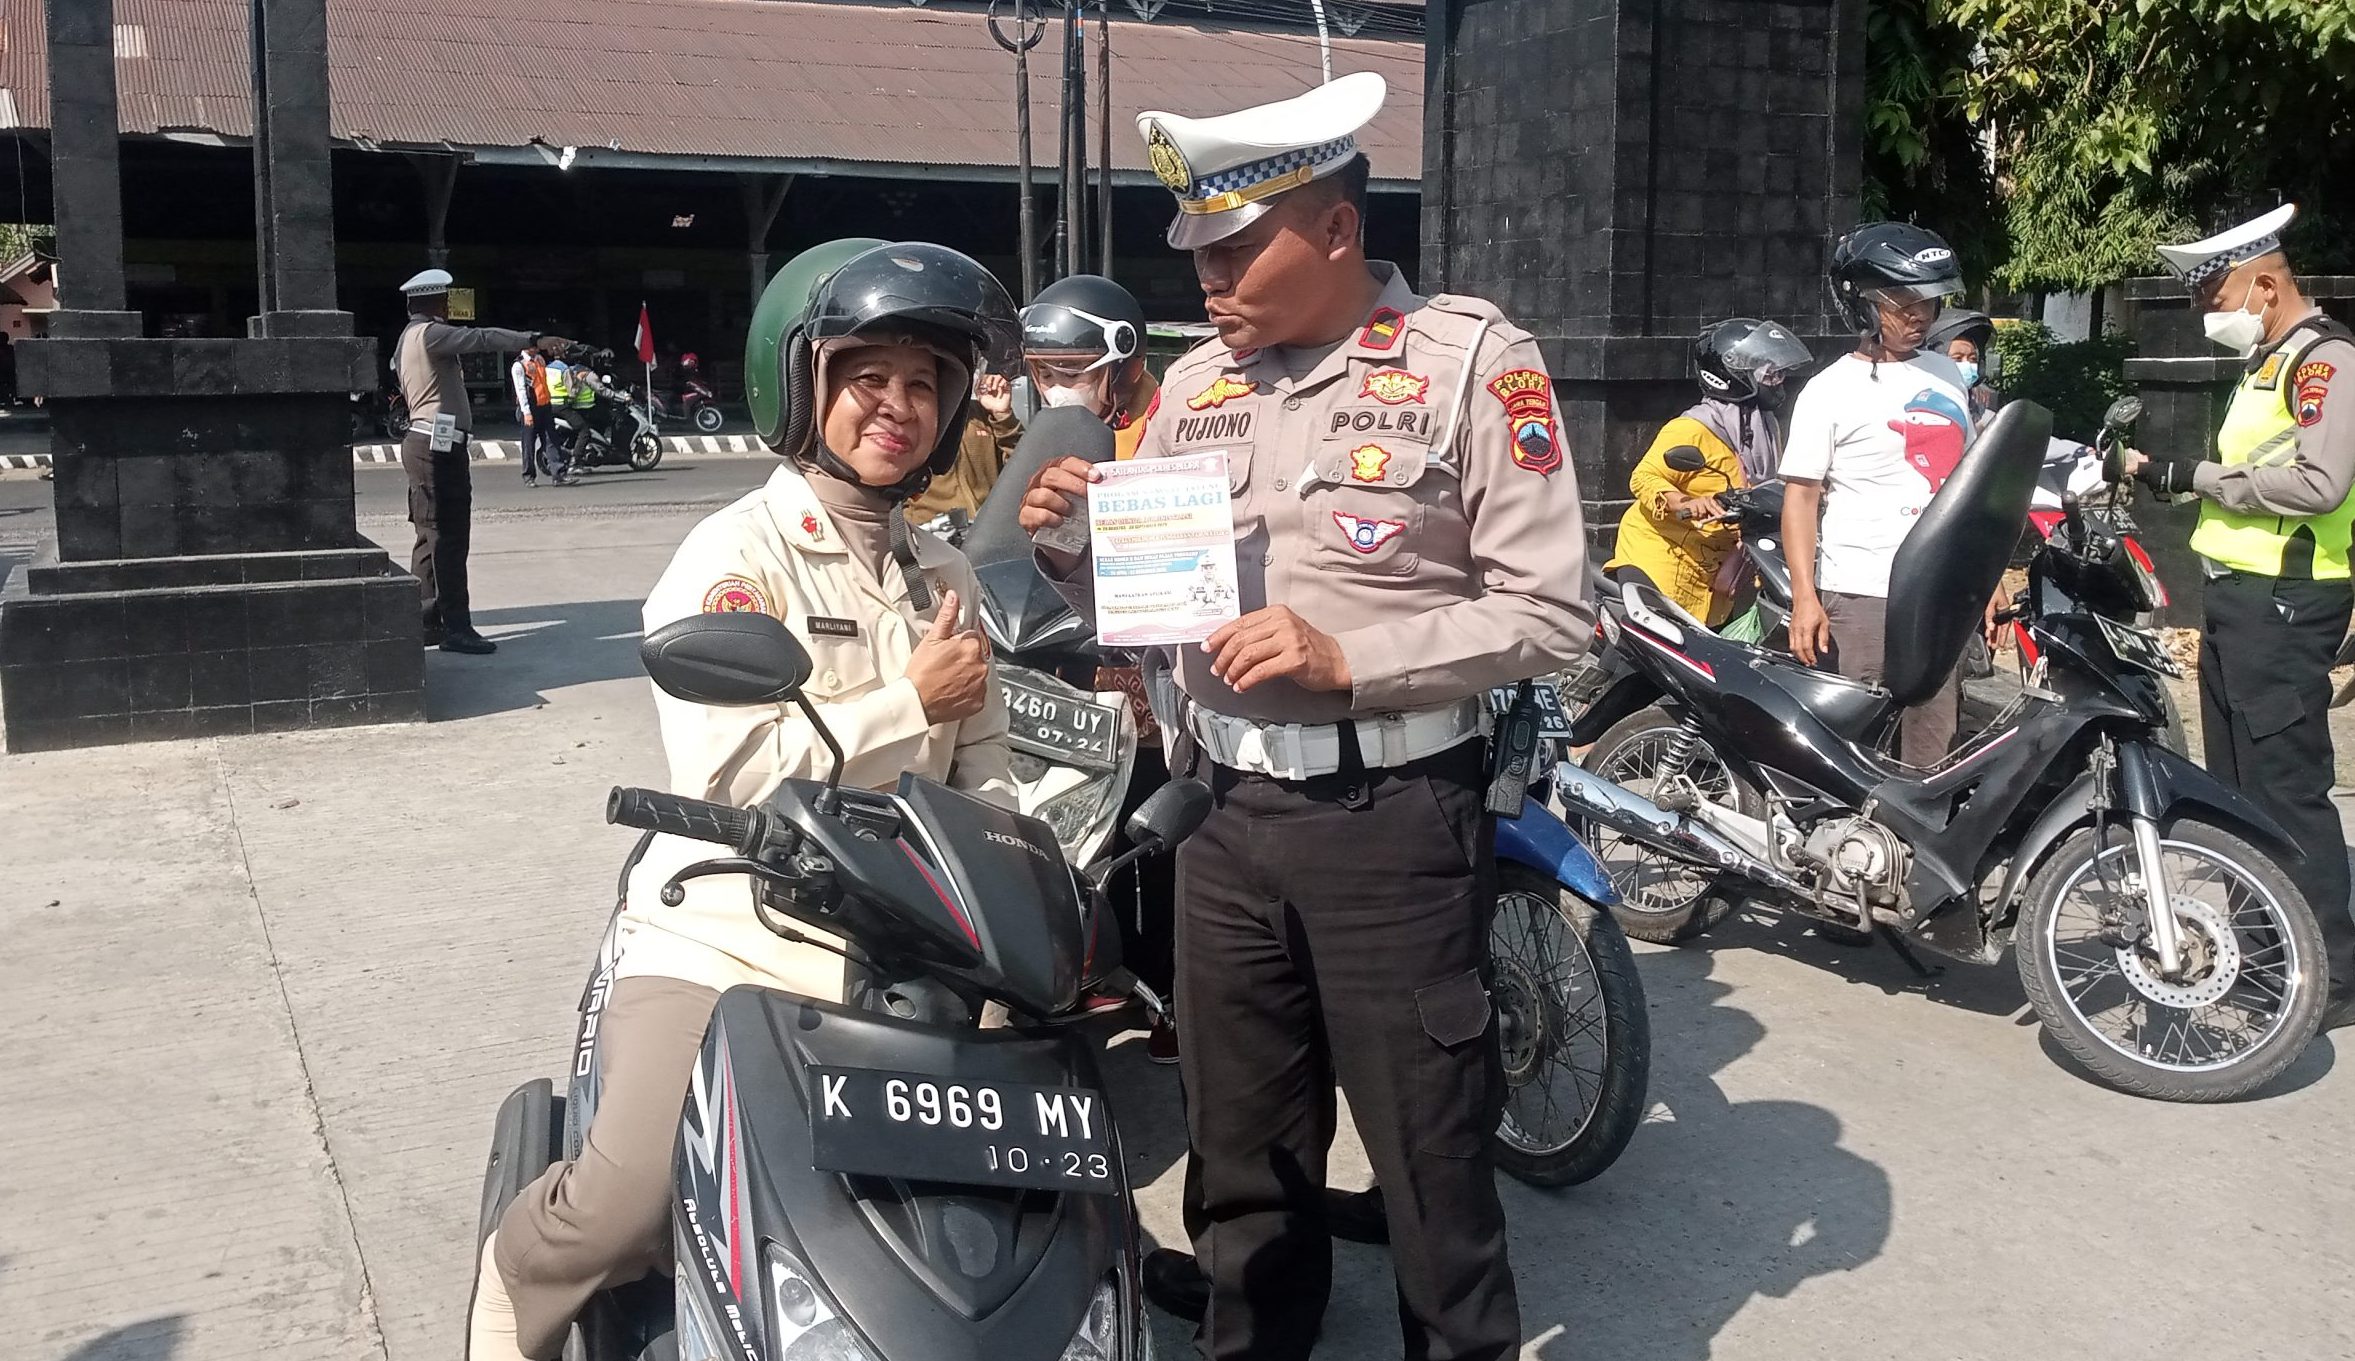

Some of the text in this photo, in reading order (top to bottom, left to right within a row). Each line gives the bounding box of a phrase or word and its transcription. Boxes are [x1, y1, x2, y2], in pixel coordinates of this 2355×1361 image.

[1494, 371, 1546, 391] POLRES
[1500, 380, 1545, 398] BLORA
[1175, 411, 1251, 443] PUJIONO
[1330, 411, 1429, 436] POLRI
[1098, 491, 1223, 514] BEBAS LAGI
[814, 621, 852, 633] MARLIYANI
[1073, 708, 1103, 734] UY
[983, 830, 1051, 862] HONDA
[576, 957, 618, 1078] VARIO
[822, 1074, 1092, 1140] K 6969 MY
